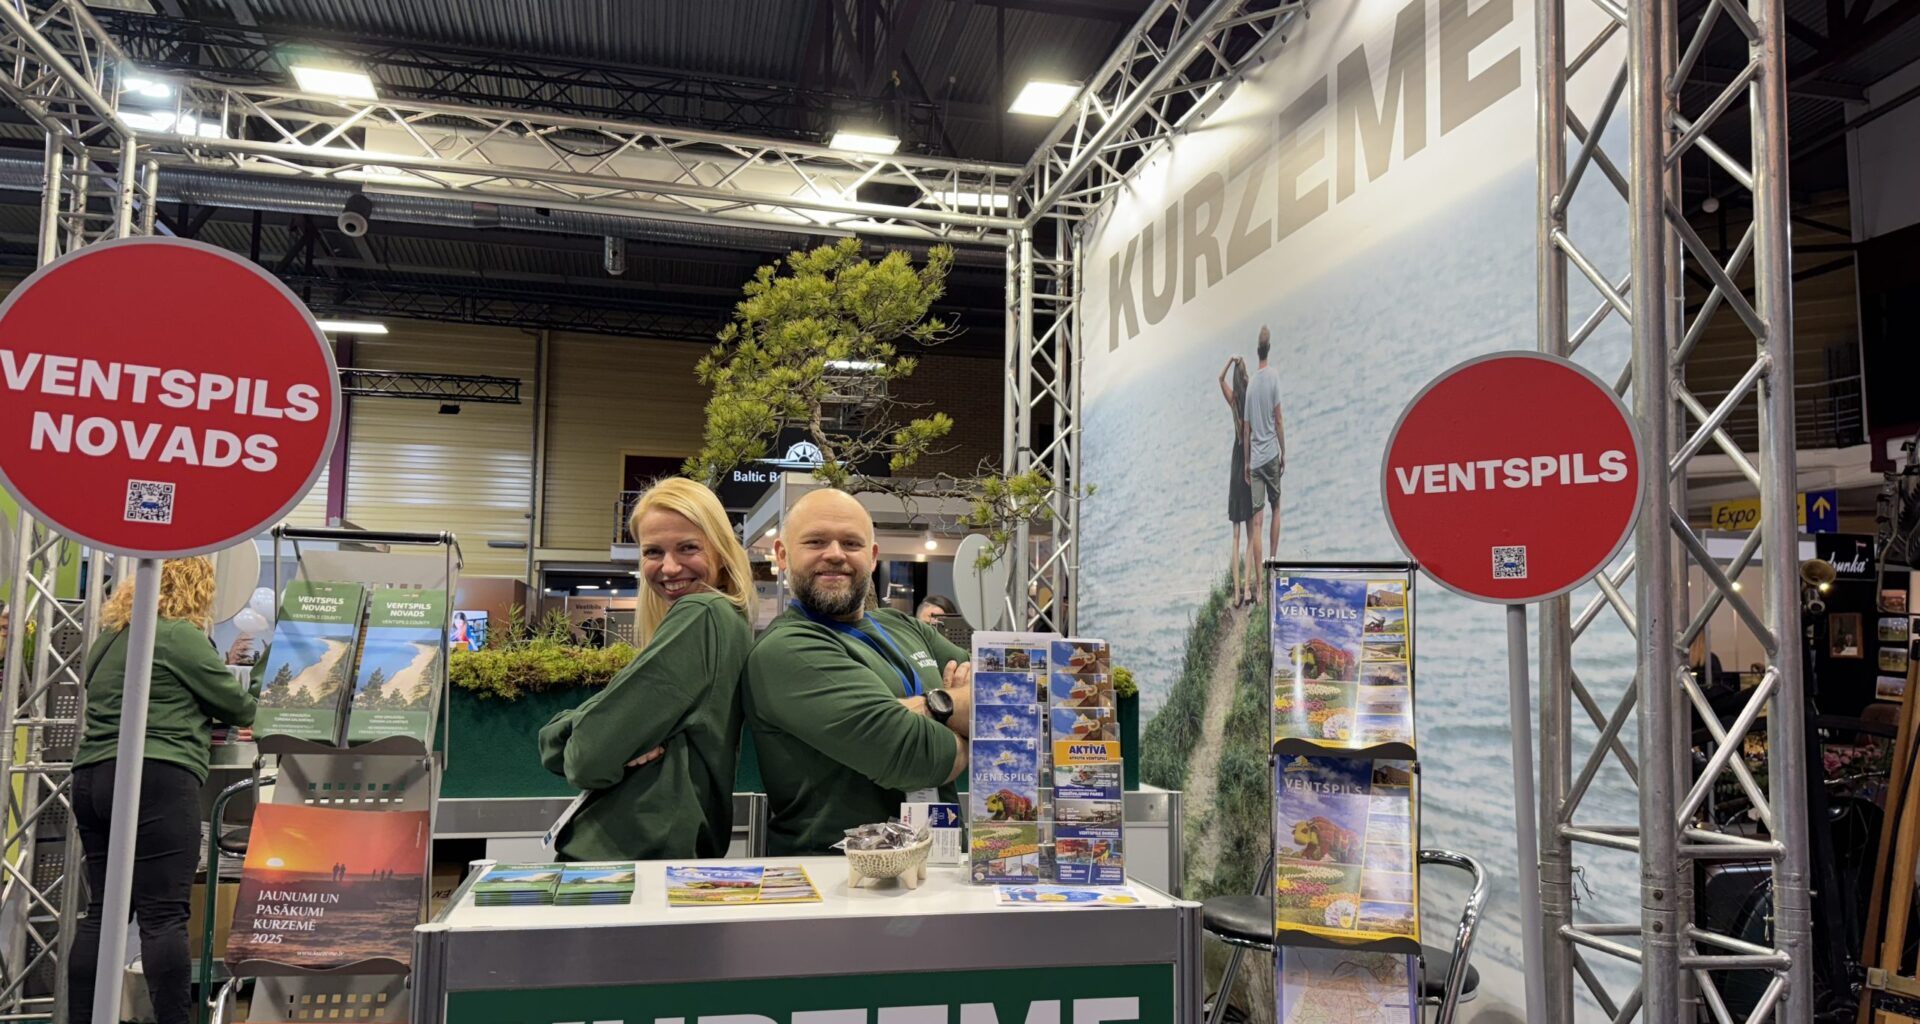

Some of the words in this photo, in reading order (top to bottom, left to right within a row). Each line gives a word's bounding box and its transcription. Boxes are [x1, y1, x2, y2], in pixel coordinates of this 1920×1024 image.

[1109, 0, 1521, 352] KURZEME
[0, 350, 320, 422] VENTSPILS
[30, 411, 279, 472] NOVADS
[733, 470, 766, 482] Baltic
[1395, 450, 1628, 495] VENTSPILS
[1716, 506, 1756, 528] Expo
[298, 595, 344, 604] VENTSPILS
[386, 602, 432, 610] VENTSPILS
[301, 604, 337, 612] NOVADS
[1280, 606, 1358, 619] VENTSPILS
[976, 772, 1034, 782] VENTSPILS
[1284, 778, 1363, 795] VENTSPILS
[258, 890, 318, 903] JAUNUMI
[320, 893, 340, 903] UN
[256, 904, 324, 917] PASĀKUMI
[253, 918, 316, 931] KURZEMĒ
[250, 933, 284, 944] 2025
